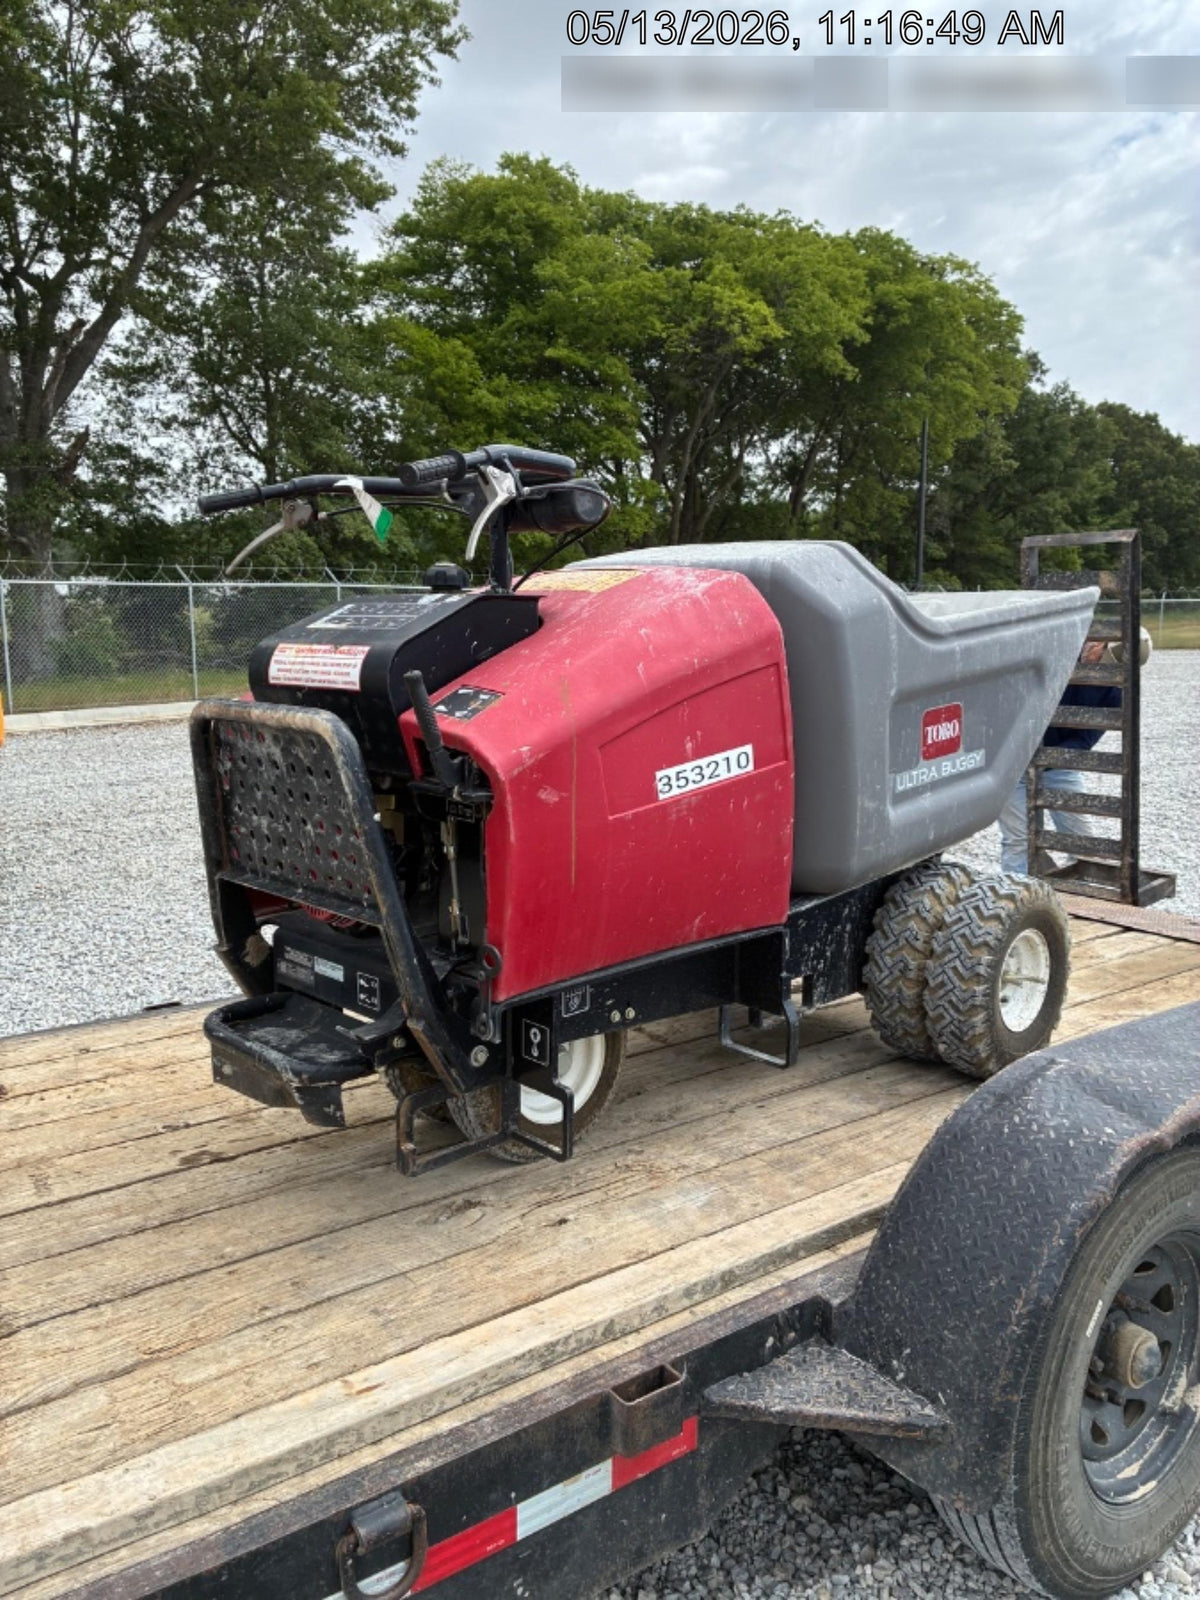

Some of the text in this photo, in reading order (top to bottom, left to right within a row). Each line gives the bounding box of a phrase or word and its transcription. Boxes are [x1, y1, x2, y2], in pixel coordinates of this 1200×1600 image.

[925, 719, 959, 744] TORO
[657, 751, 750, 794] 353210
[896, 751, 982, 790] ULTRA BUGGY
